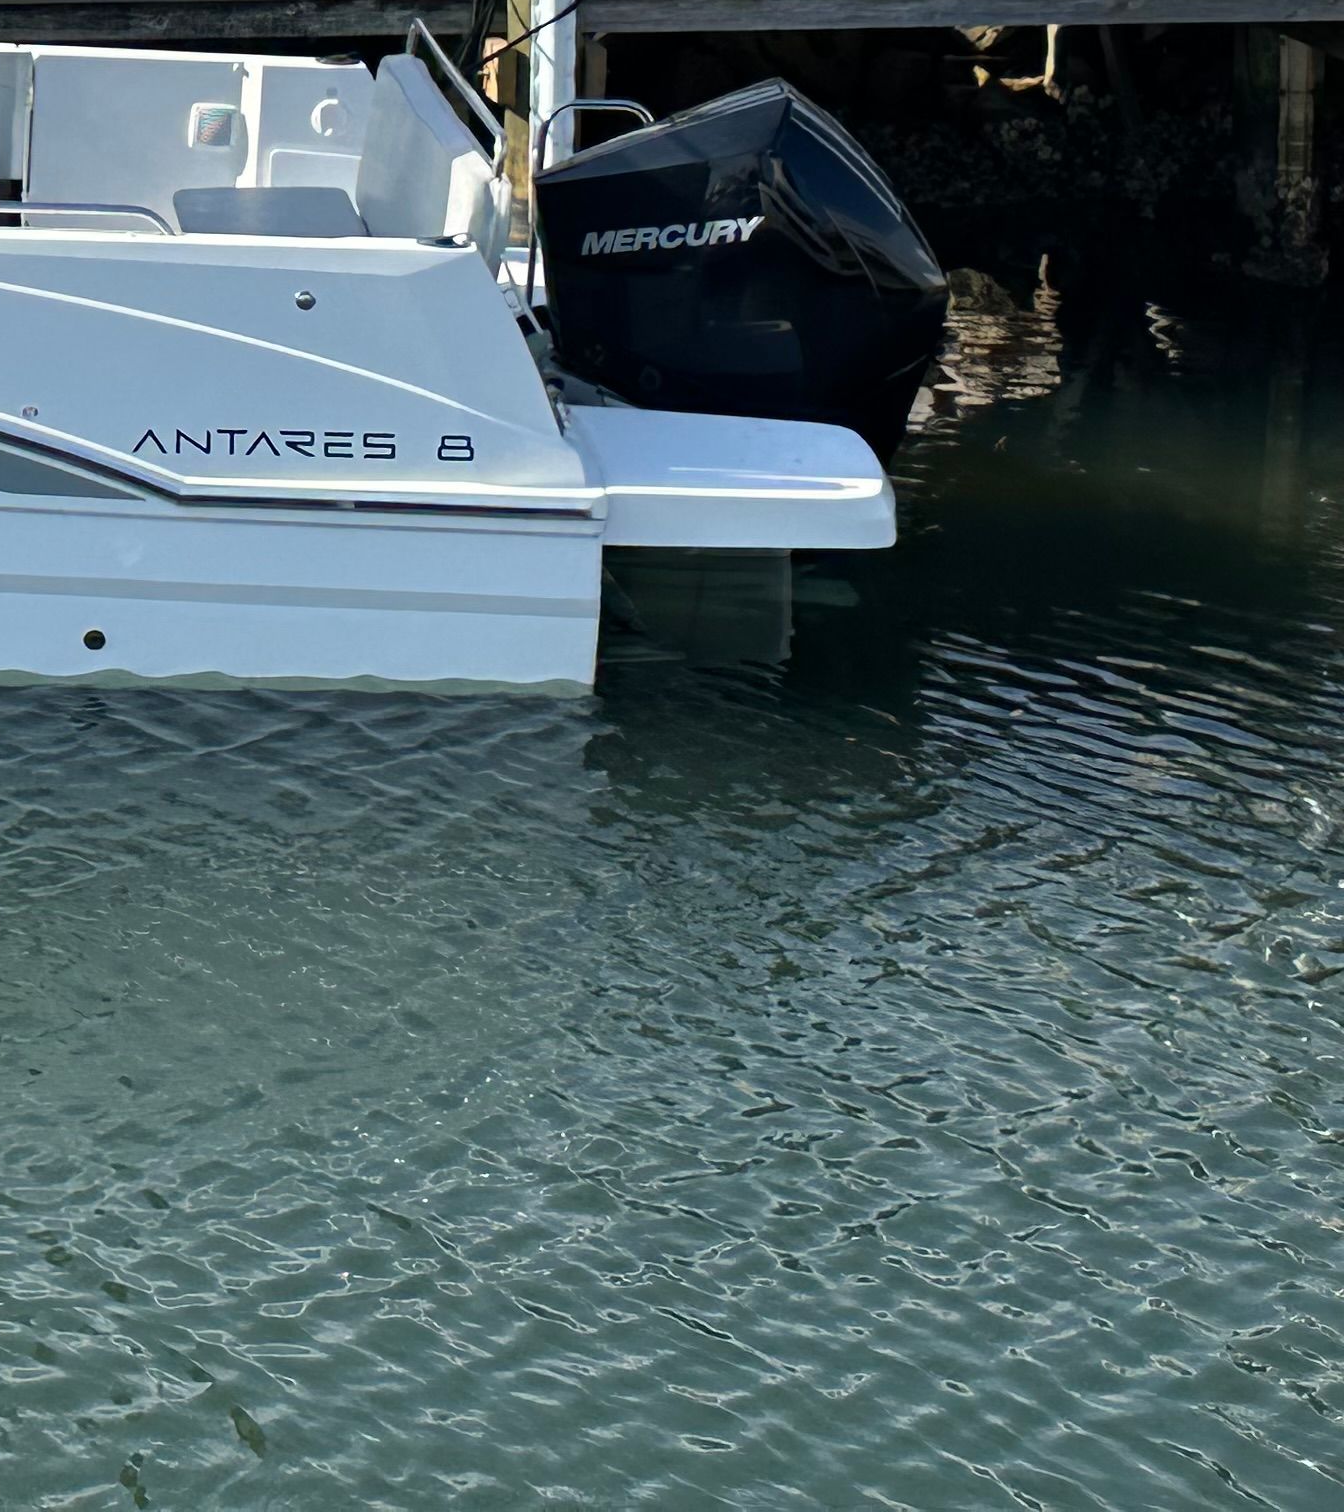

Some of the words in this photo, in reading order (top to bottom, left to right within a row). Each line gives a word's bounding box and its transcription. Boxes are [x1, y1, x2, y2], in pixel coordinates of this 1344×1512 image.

[581, 215, 766, 256] MERCURY
[132, 429, 397, 459] ANTARES
[437, 435, 475, 461] 8
